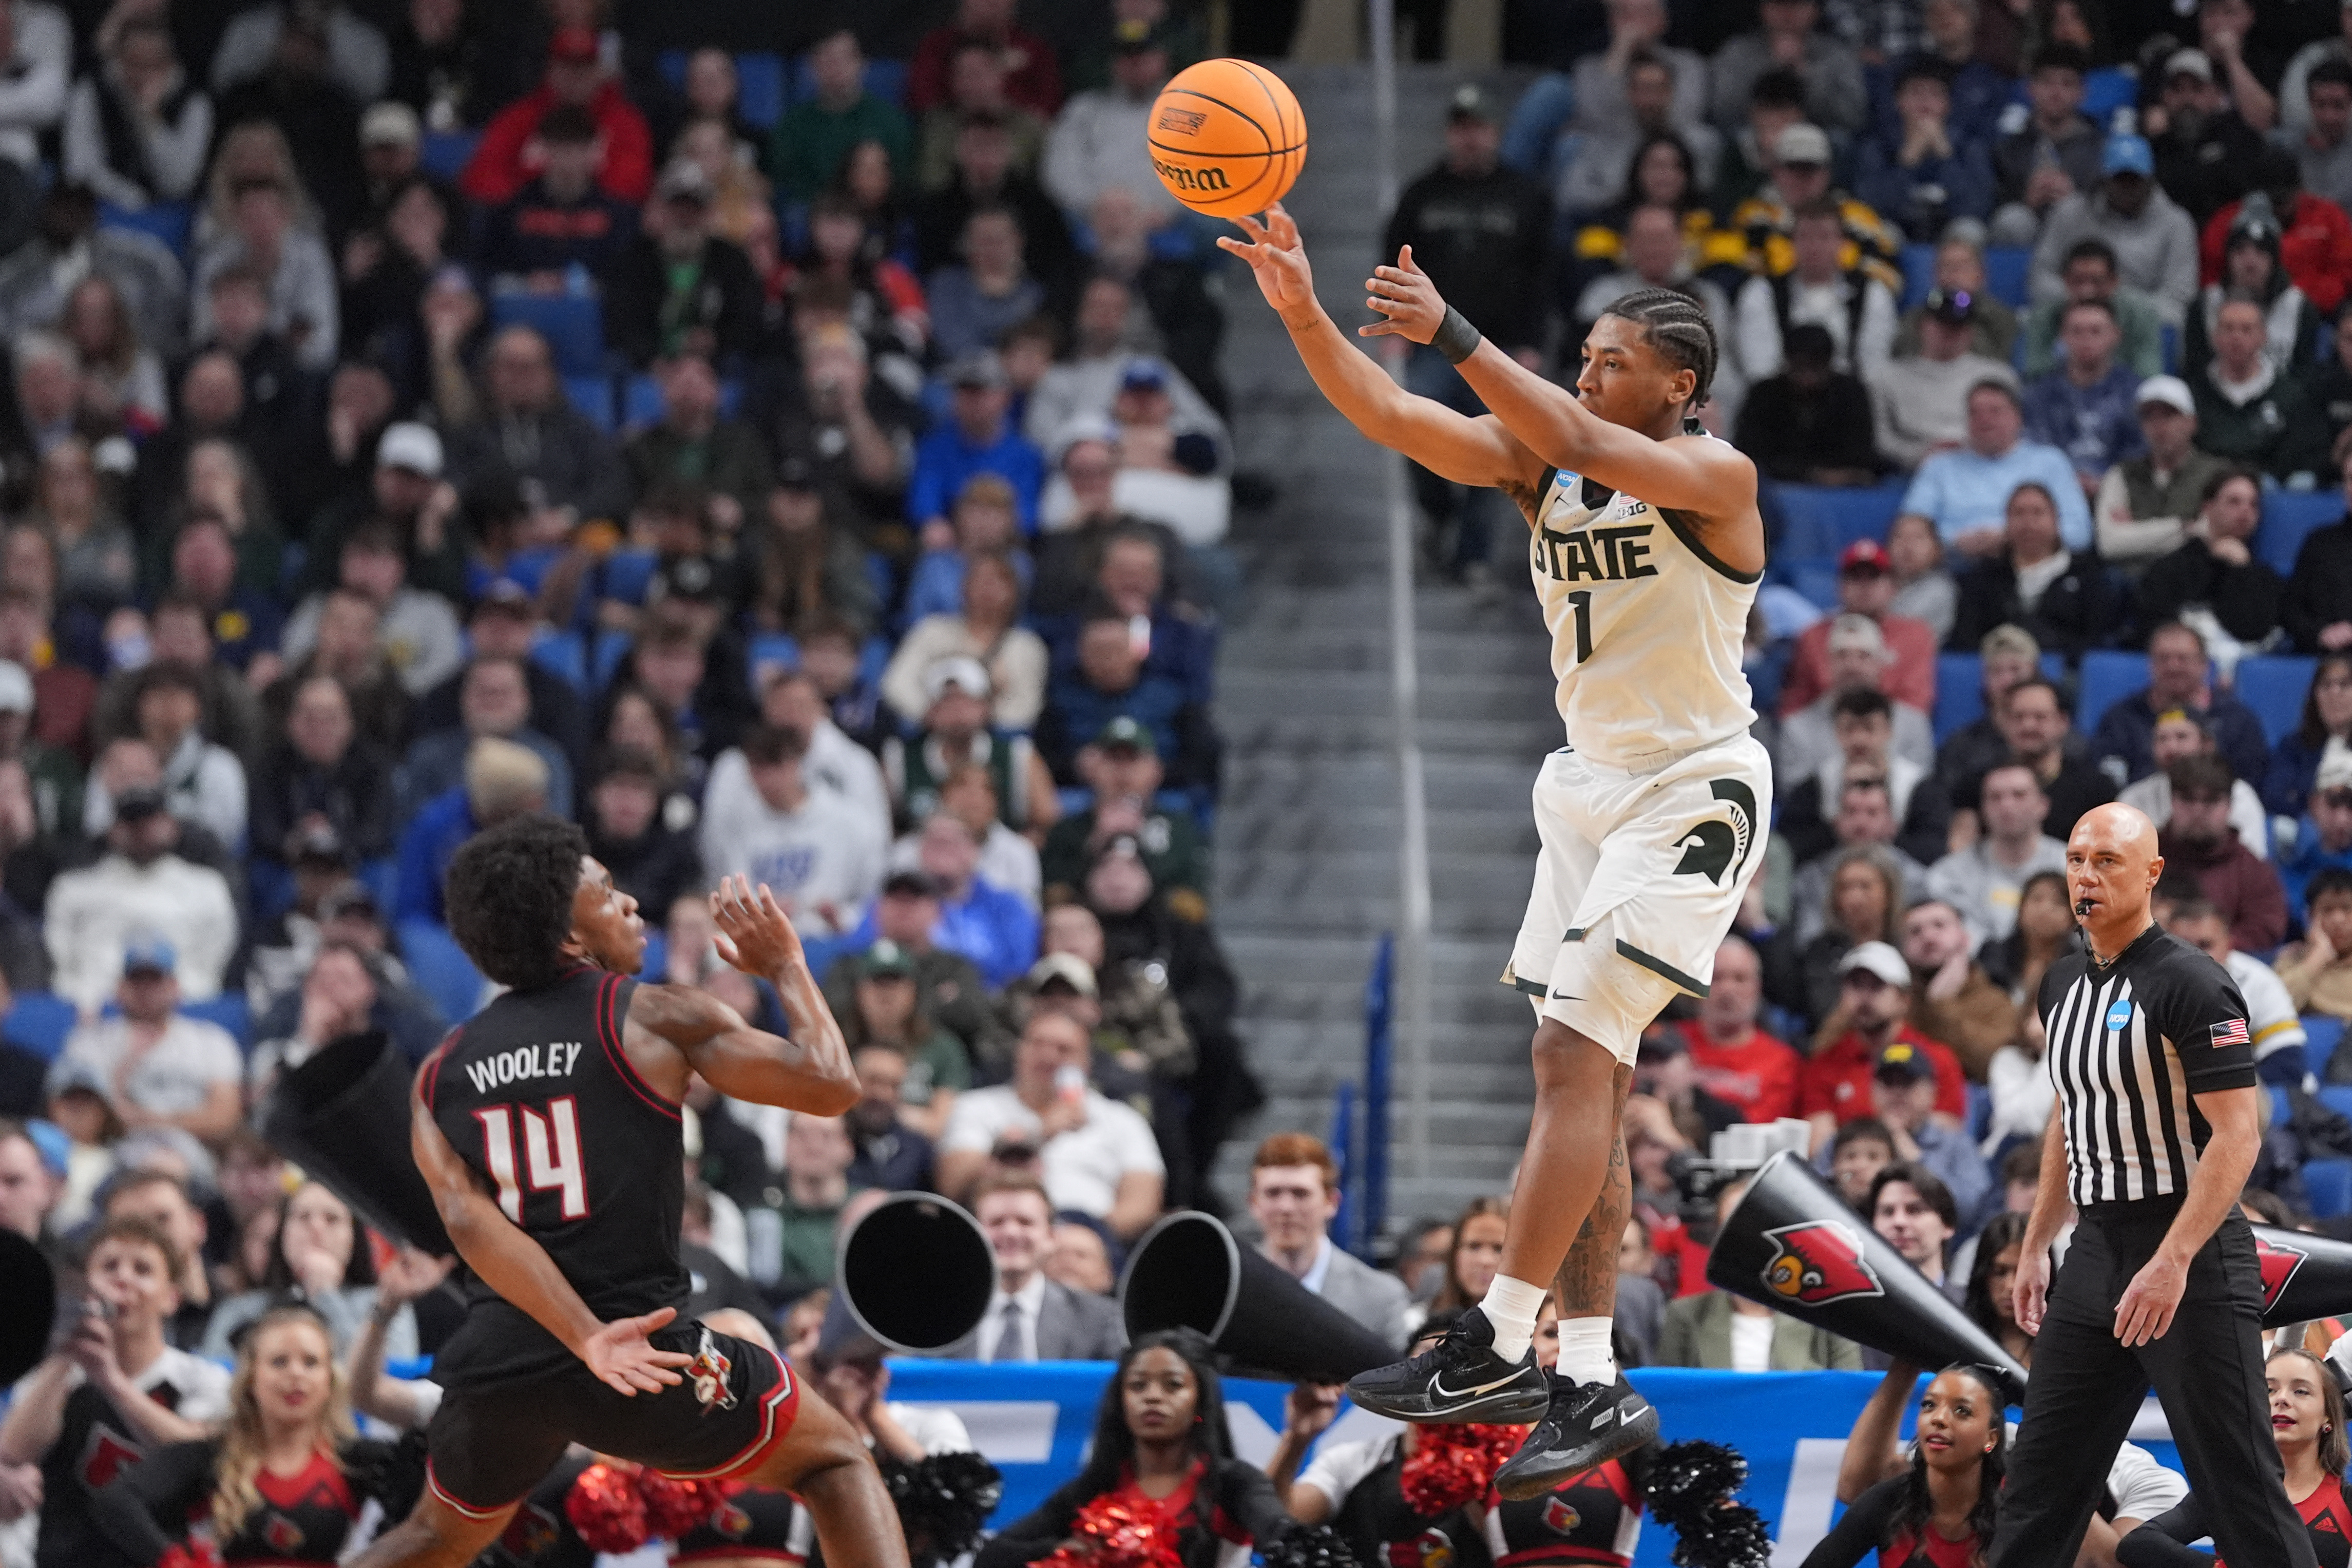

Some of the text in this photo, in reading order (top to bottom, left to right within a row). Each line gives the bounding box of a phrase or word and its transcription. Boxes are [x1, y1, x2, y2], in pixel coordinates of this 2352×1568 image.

[1557, 472, 1578, 483] NCAA
[1569, 590, 1594, 663] 1
[2108, 1014, 2129, 1023] NCAA
[465, 1042, 583, 1094] WOOLEY
[470, 1094, 590, 1227] 14
